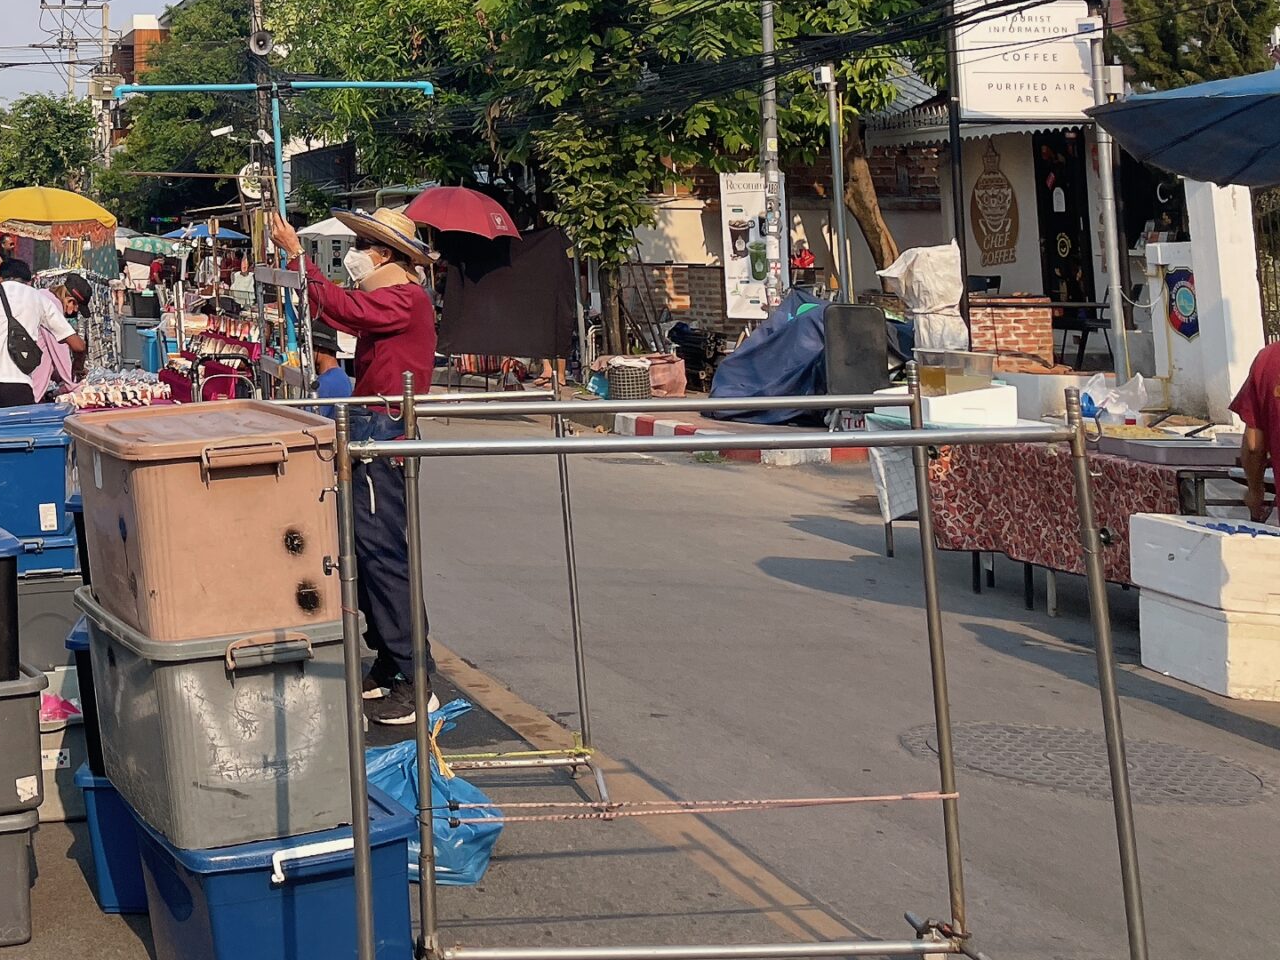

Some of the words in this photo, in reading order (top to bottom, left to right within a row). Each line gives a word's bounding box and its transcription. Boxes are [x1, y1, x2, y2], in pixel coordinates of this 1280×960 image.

[1005, 15, 1051, 23] TOURIST
[988, 25, 1068, 34] INFORMATION
[1002, 52, 1058, 62] COFFEE
[987, 82, 1047, 91] PURIFIED
[1055, 82, 1075, 91] AIR
[1016, 95, 1049, 103] AREA
[983, 232, 1011, 250] CHEF
[981, 248, 1017, 267] COFFEE
